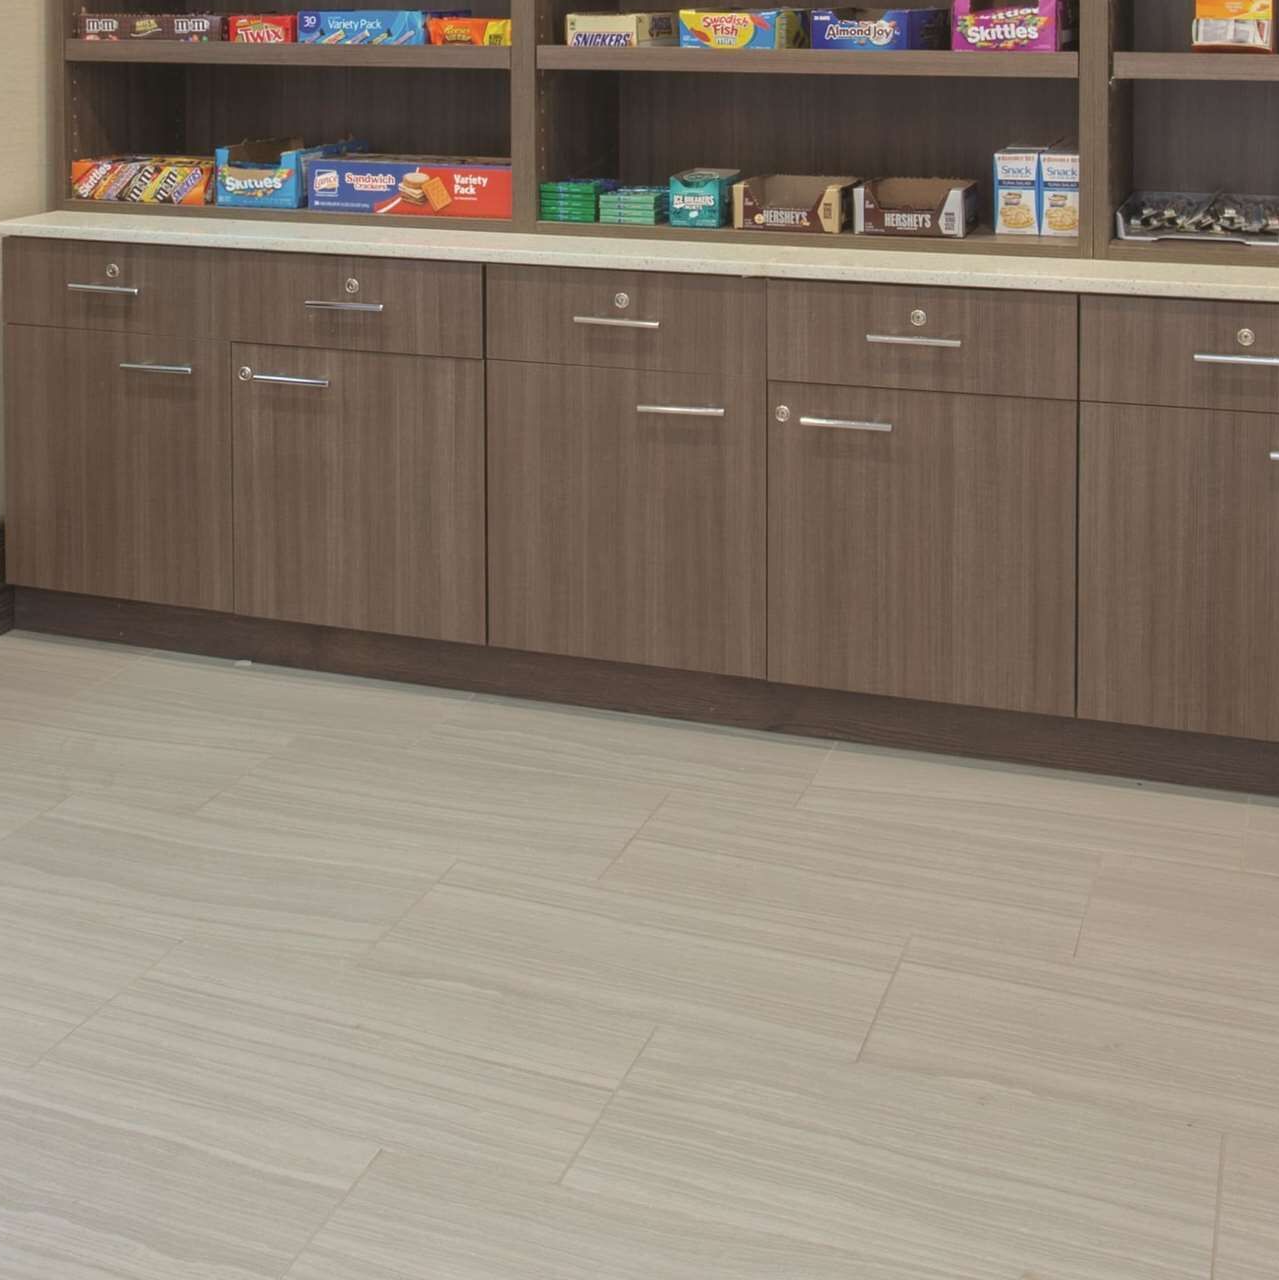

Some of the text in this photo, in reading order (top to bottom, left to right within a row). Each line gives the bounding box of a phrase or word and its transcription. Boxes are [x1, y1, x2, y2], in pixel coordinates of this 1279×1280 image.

[303, 16, 318, 28] 30
[327, 18, 382, 31] Variety Pack
[702, 15, 749, 27] Swedish
[238, 27, 285, 44] TWIX
[713, 25, 738, 36] Fish
[826, 23, 893, 40] Almond Joy
[968, 23, 1039, 43] Skittles
[573, 32, 632, 47] SNICKERS
[1001, 165, 1032, 176] Snack
[1047, 166, 1078, 177] Snack
[345, 174, 395, 187] Sandwich
[453, 174, 489, 188] Variety
[453, 185, 476, 195] Pack
[763, 209, 808, 225] HERSHEY'S
[884, 213, 932, 229] HERSHEY'S
